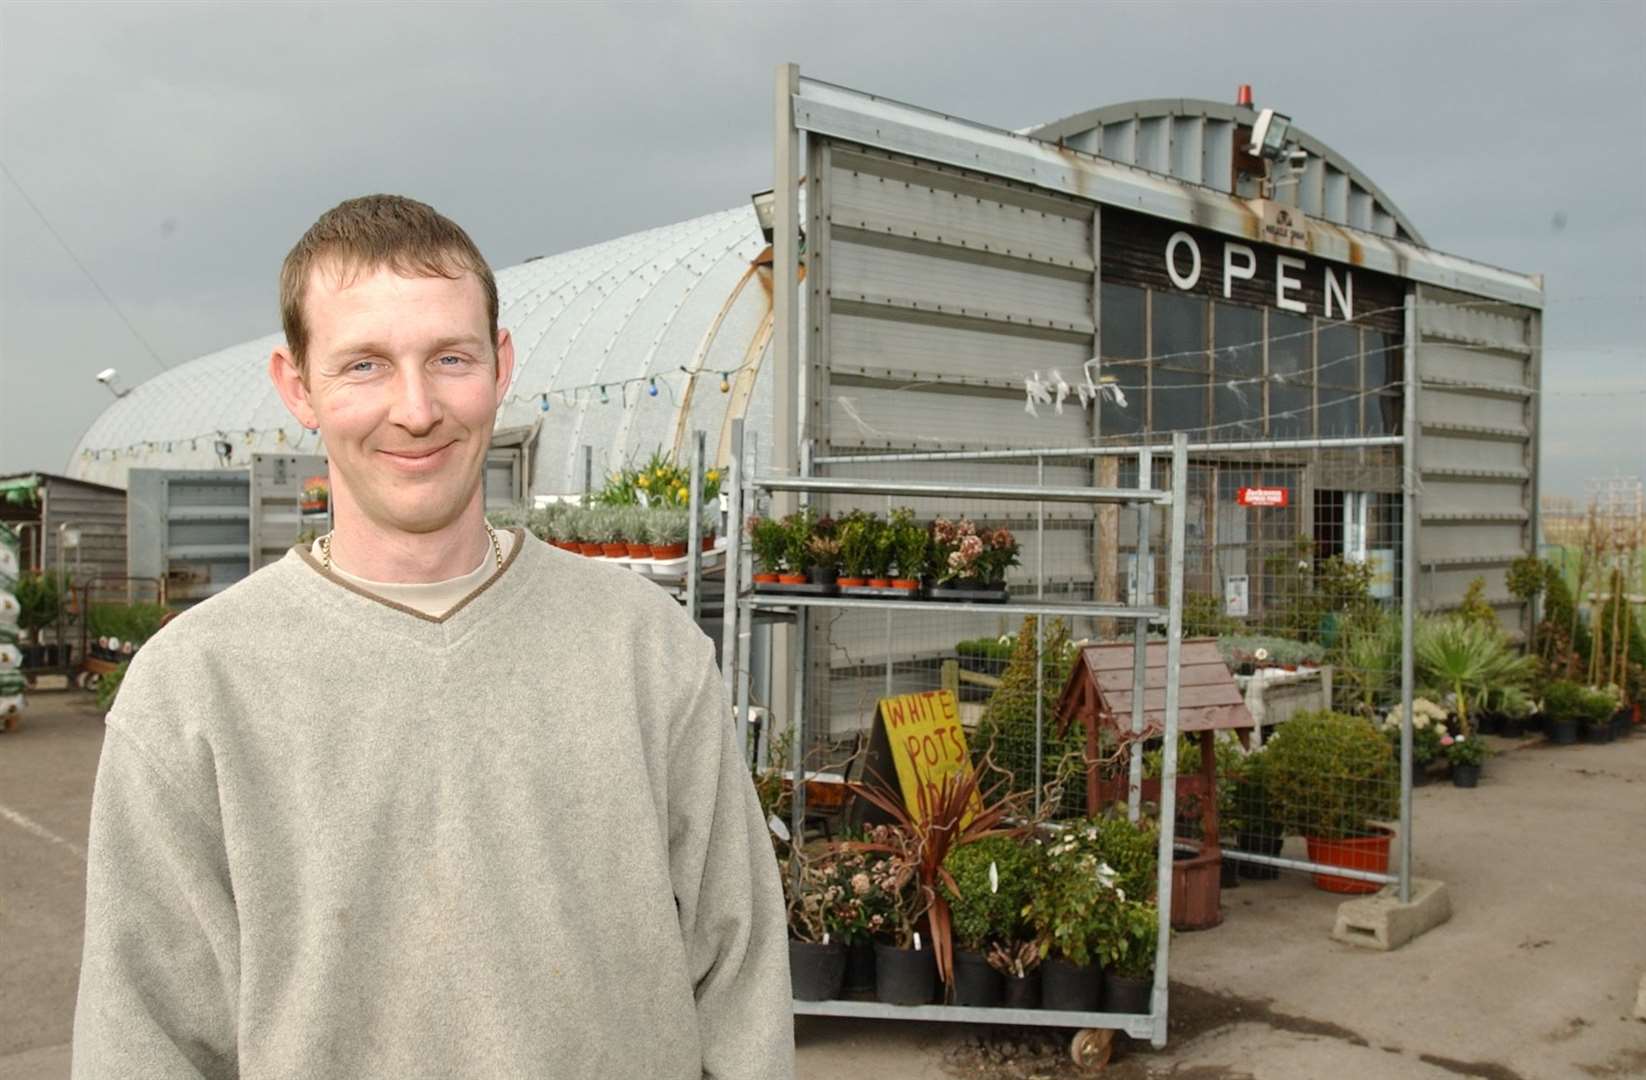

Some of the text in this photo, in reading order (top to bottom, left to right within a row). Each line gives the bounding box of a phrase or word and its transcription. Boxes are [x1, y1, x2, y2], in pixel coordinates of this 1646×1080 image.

[1165, 231, 1353, 321] OPEN
[887, 690, 954, 729] WHITE
[906, 726, 965, 766] POTS
